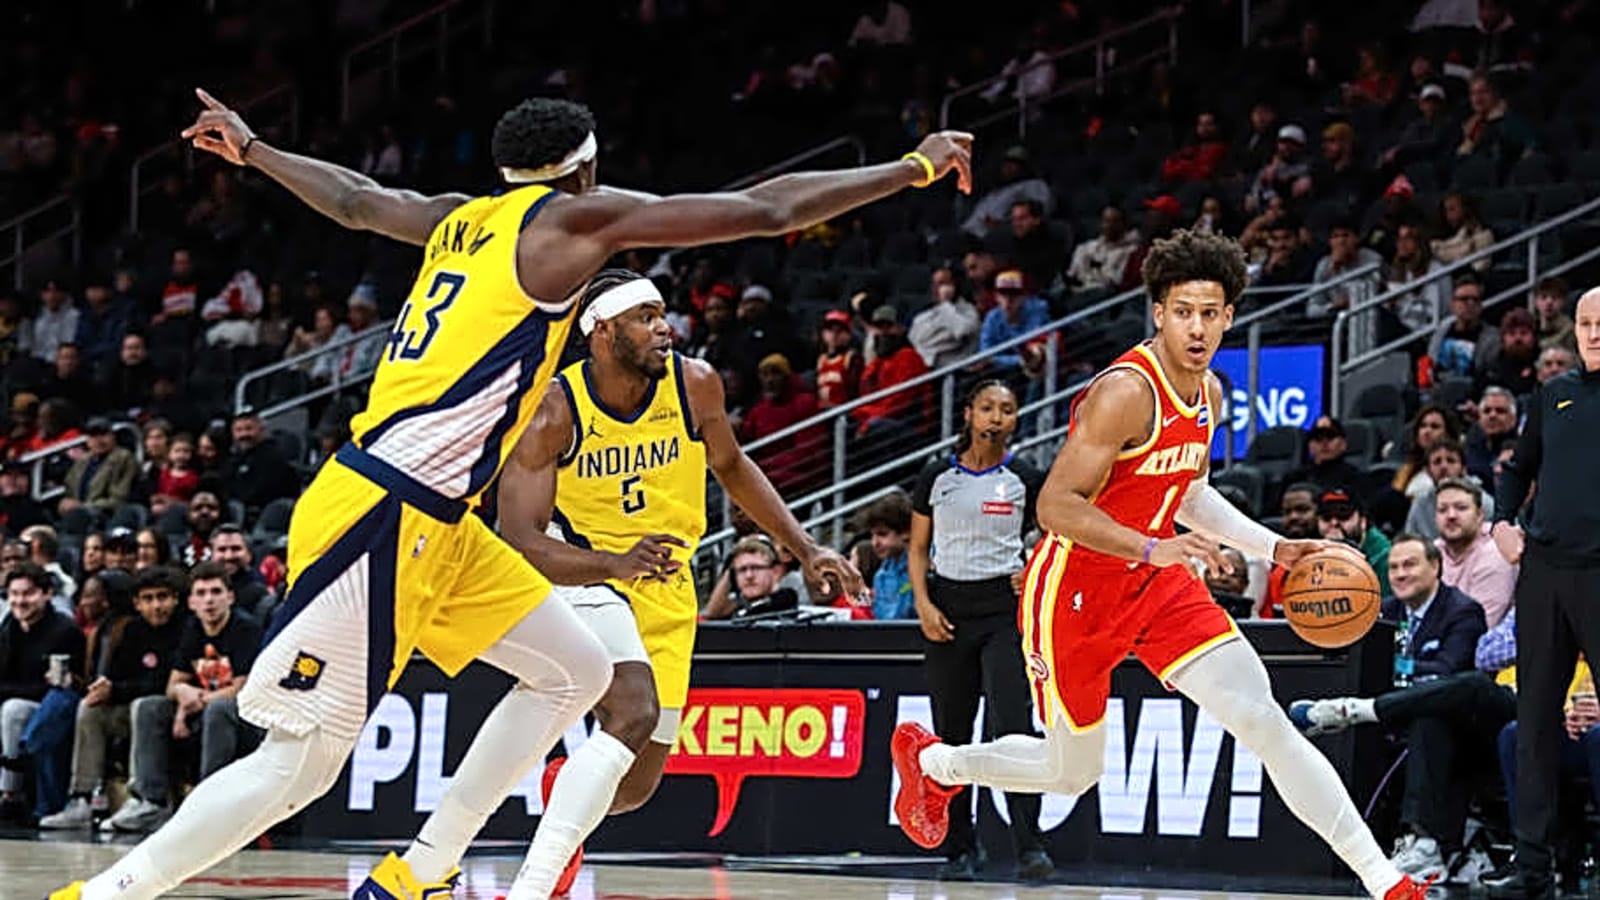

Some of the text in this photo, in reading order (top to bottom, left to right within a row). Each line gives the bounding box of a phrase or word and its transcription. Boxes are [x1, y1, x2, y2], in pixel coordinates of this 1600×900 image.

[388, 271, 467, 363] 43
[577, 436, 679, 478] INDIANA
[622, 475, 646, 514] 5
[1147, 484, 1179, 532] 1
[1290, 596, 1352, 618] Wilson
[348, 692, 602, 816] PL
[669, 705, 848, 758] KENO!
